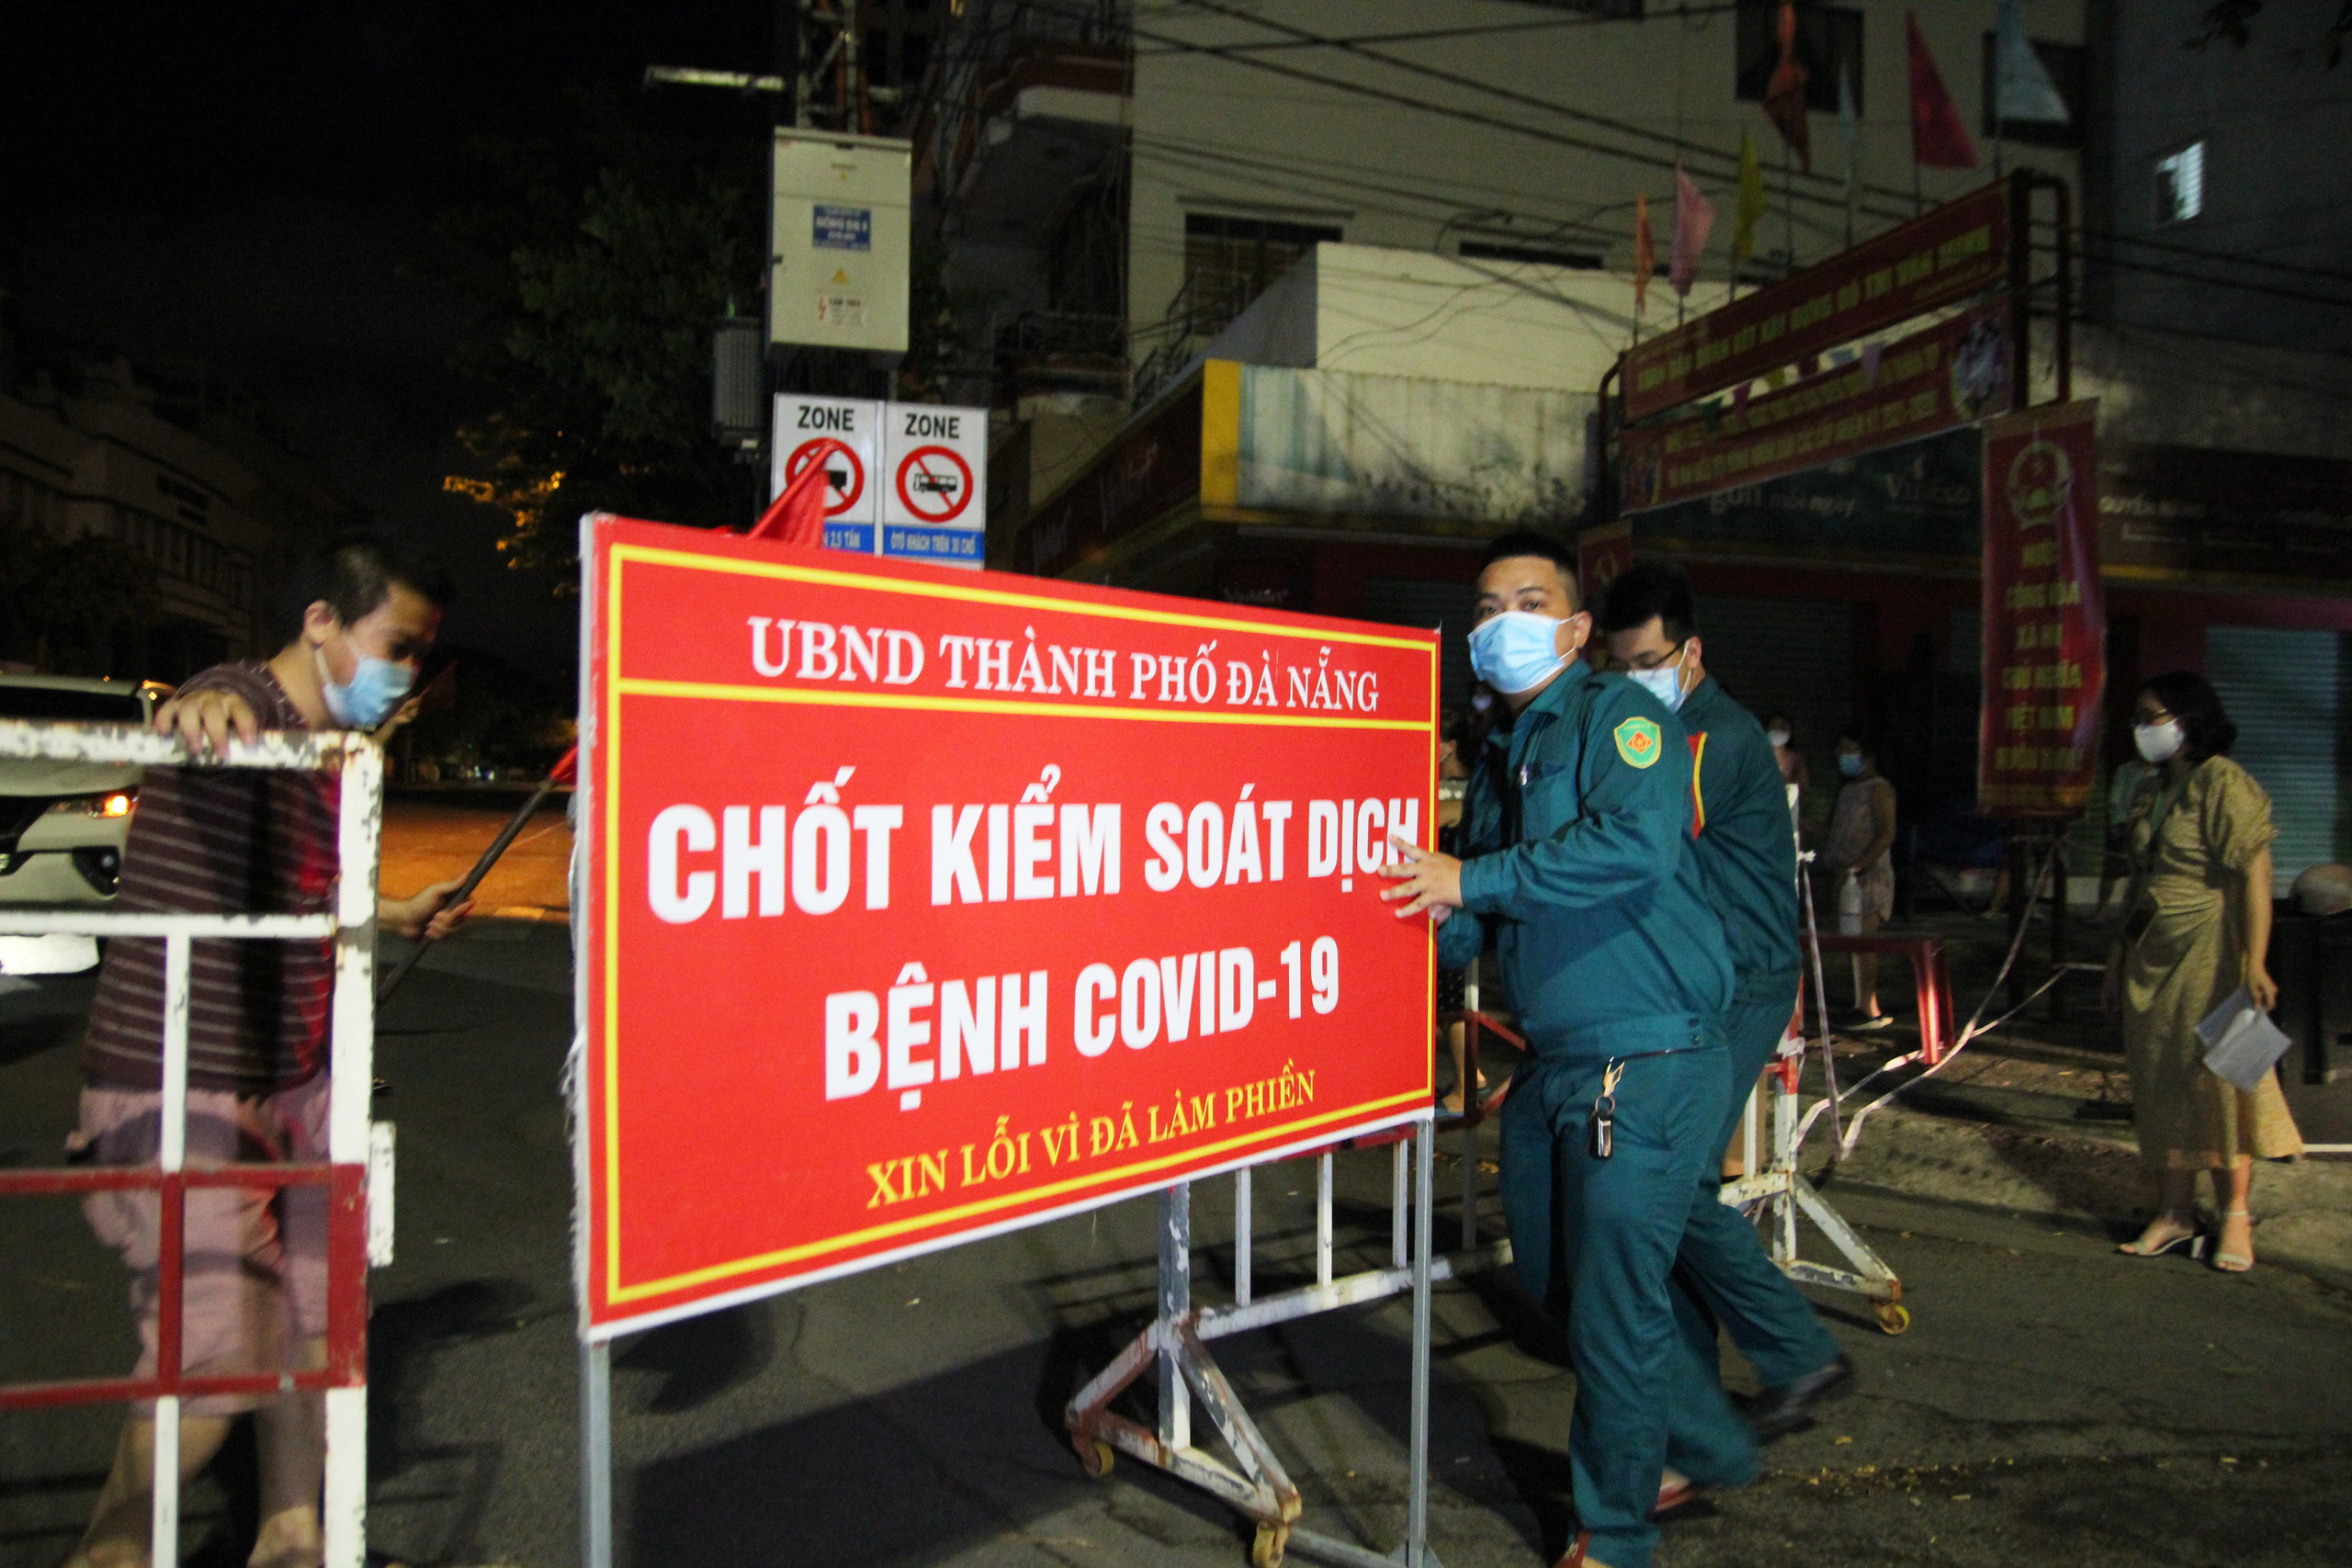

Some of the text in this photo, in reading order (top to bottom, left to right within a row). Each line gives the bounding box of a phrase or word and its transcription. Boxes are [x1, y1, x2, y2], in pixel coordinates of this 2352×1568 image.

[797, 405, 854, 432] ZONE
[904, 412, 960, 439] ZONE
[746, 615, 1379, 713] UBND THÀNH PHỐ ĐÀ NẴNG
[648, 763, 1419, 925] CHỐT KIỂM SOÁT DỊCH
[825, 935, 1340, 1111] BỆNH COVID-19
[866, 1057, 1317, 1209] XIN LỖI VÌ ĐÃ LÀM PHIỀN
